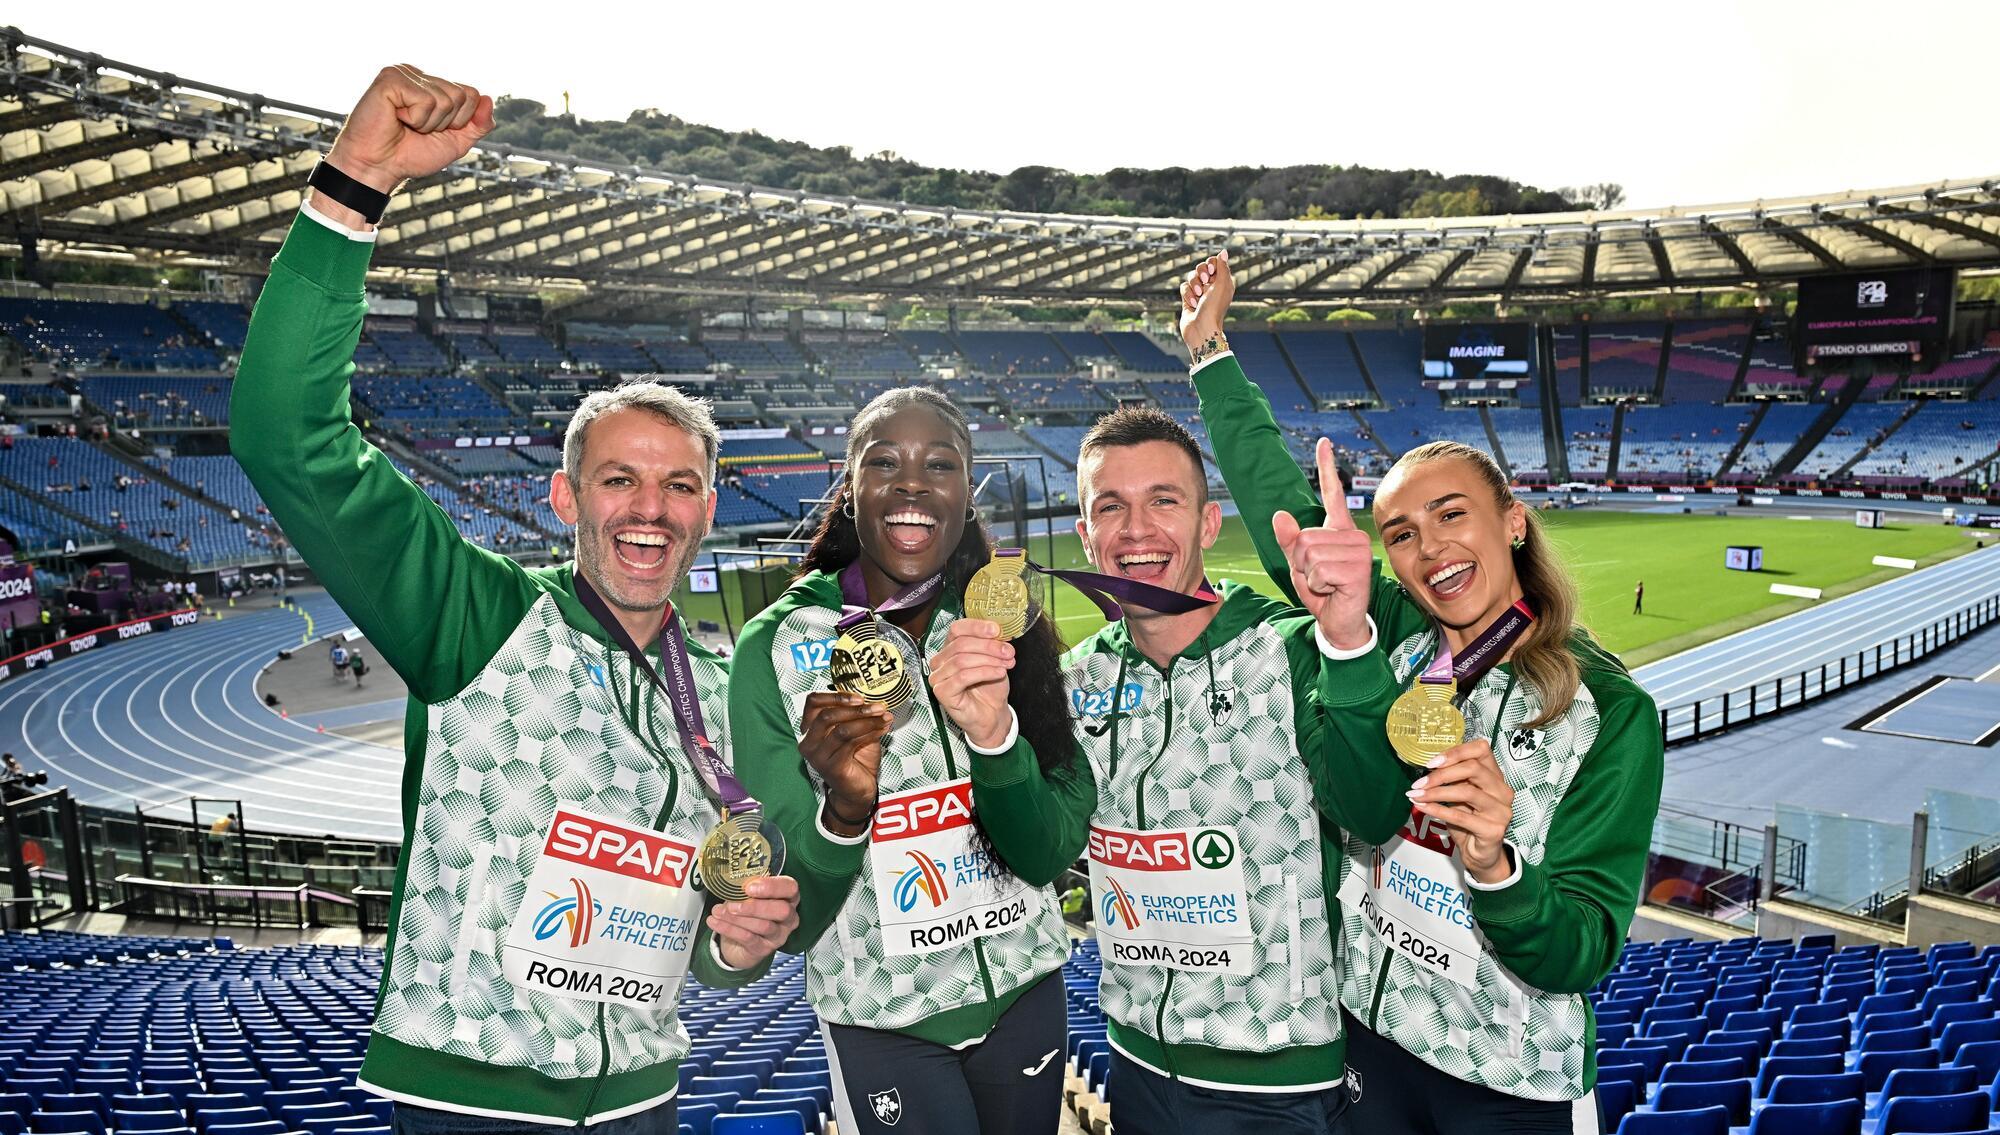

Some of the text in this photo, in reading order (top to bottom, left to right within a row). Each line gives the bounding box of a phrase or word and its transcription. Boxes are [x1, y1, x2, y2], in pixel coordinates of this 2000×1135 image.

[1808, 316, 1937, 329] EUROPEAN CHAMPIONSHIPS
[1449, 346, 1505, 358] IMAGINE
[1818, 343, 1907, 355] STADIO OLIMPICO
[1712, 486, 1738, 494] TOYOTA
[1840, 490, 1864, 498] TOYOTA
[1881, 492, 1907, 500] TOYOTA
[1922, 494, 1946, 502] TOYOTA
[1962, 496, 1987, 504] TOYOTA
[65, 540, 76, 553] A
[70, 635, 97, 653] TOYOTA
[118, 622, 152, 639] TOYOTA
[1492, 616, 1520, 643] CHAMPIONSHIPS
[666, 628, 688, 693] CHAMPIONSHIPS
[1077, 688, 1136, 714] 123ie
[875, 788, 975, 836] SPA
[552, 820, 689, 881] SPAR
[1090, 832, 1186, 866] SPAR
[1141, 893, 1236, 909] EUROPEAN
[1387, 877, 1475, 930] ATHLETICS
[608, 906, 694, 934] EUROPEAN
[910, 898, 1027, 948] ROMA 2024
[1146, 909, 1238, 925] ATHLETICS
[600, 925, 688, 950] ATHLETICS
[1359, 892, 1451, 971] ROMA 2024
[1113, 942, 1231, 967] ROMA 2024
[526, 961, 663, 1004] ROMA 2024
